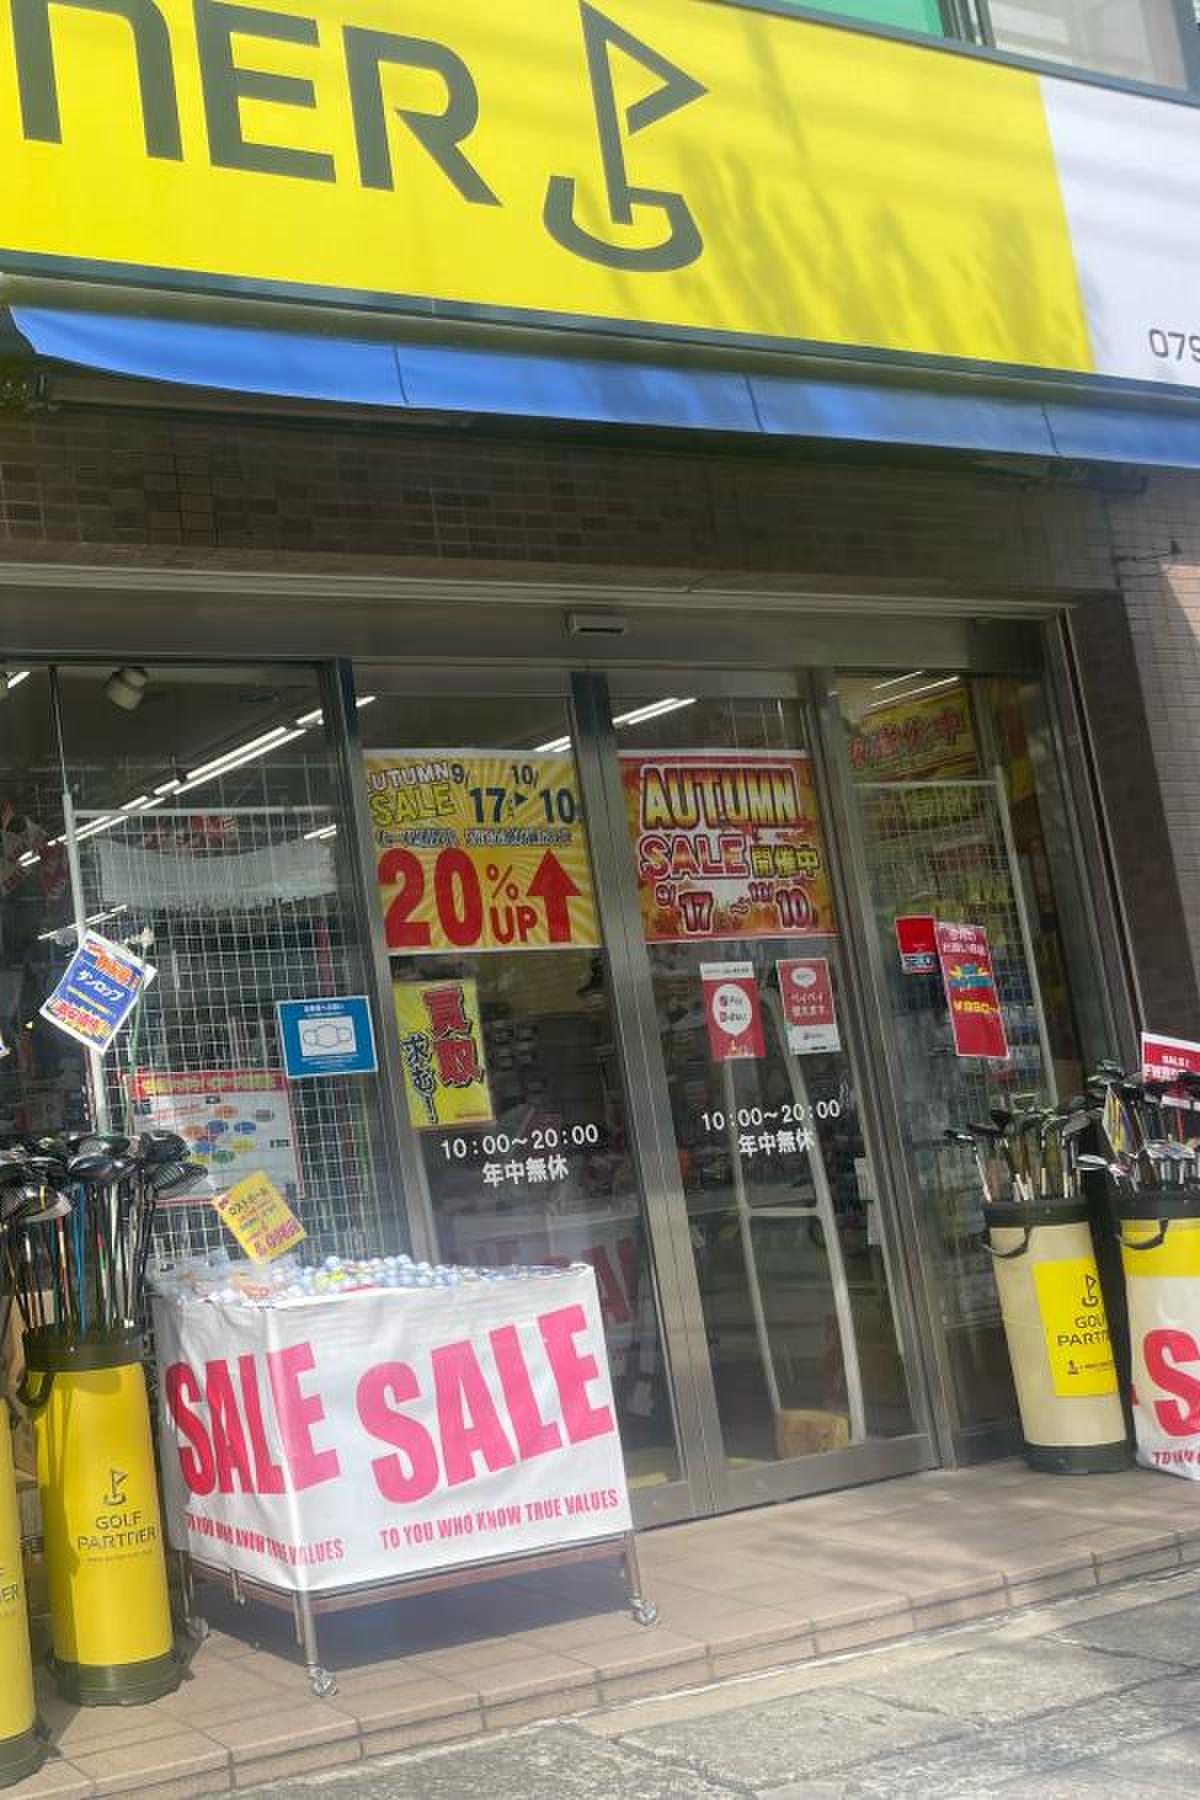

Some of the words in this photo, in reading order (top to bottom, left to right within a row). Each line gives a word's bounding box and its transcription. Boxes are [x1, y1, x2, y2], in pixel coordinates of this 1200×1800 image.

[368, 762, 448, 793] UTUMN
[369, 784, 457, 826] SALE
[470, 788, 506, 823] 17
[540, 788, 578, 823] 10
[642, 767, 799, 829] AUTUMN
[639, 835, 749, 879] SALE
[489, 905, 538, 944] UP
[679, 892, 713, 931] 17
[776, 888, 812, 929] 10
[738, 1126, 816, 1157] 年中無休
[482, 1153, 569, 1187] 年中無休
[1057, 1326, 1112, 1347] PART
[1075, 1315, 1108, 1329] GOL
[164, 1342, 340, 1497] SALE
[355, 1304, 615, 1505] SALE
[96, 1511, 143, 1530] GOLF
[379, 1528, 400, 1550] TO
[403, 1523, 433, 1547] YOU
[437, 1515, 473, 1540] WHO
[476, 1507, 522, 1534] KNOW
[525, 1500, 562, 1522] TRUE
[564, 1489, 618, 1516] VALUES
[77, 1528, 157, 1550] PARTNER
[285, 1537, 345, 1567] VALUES
